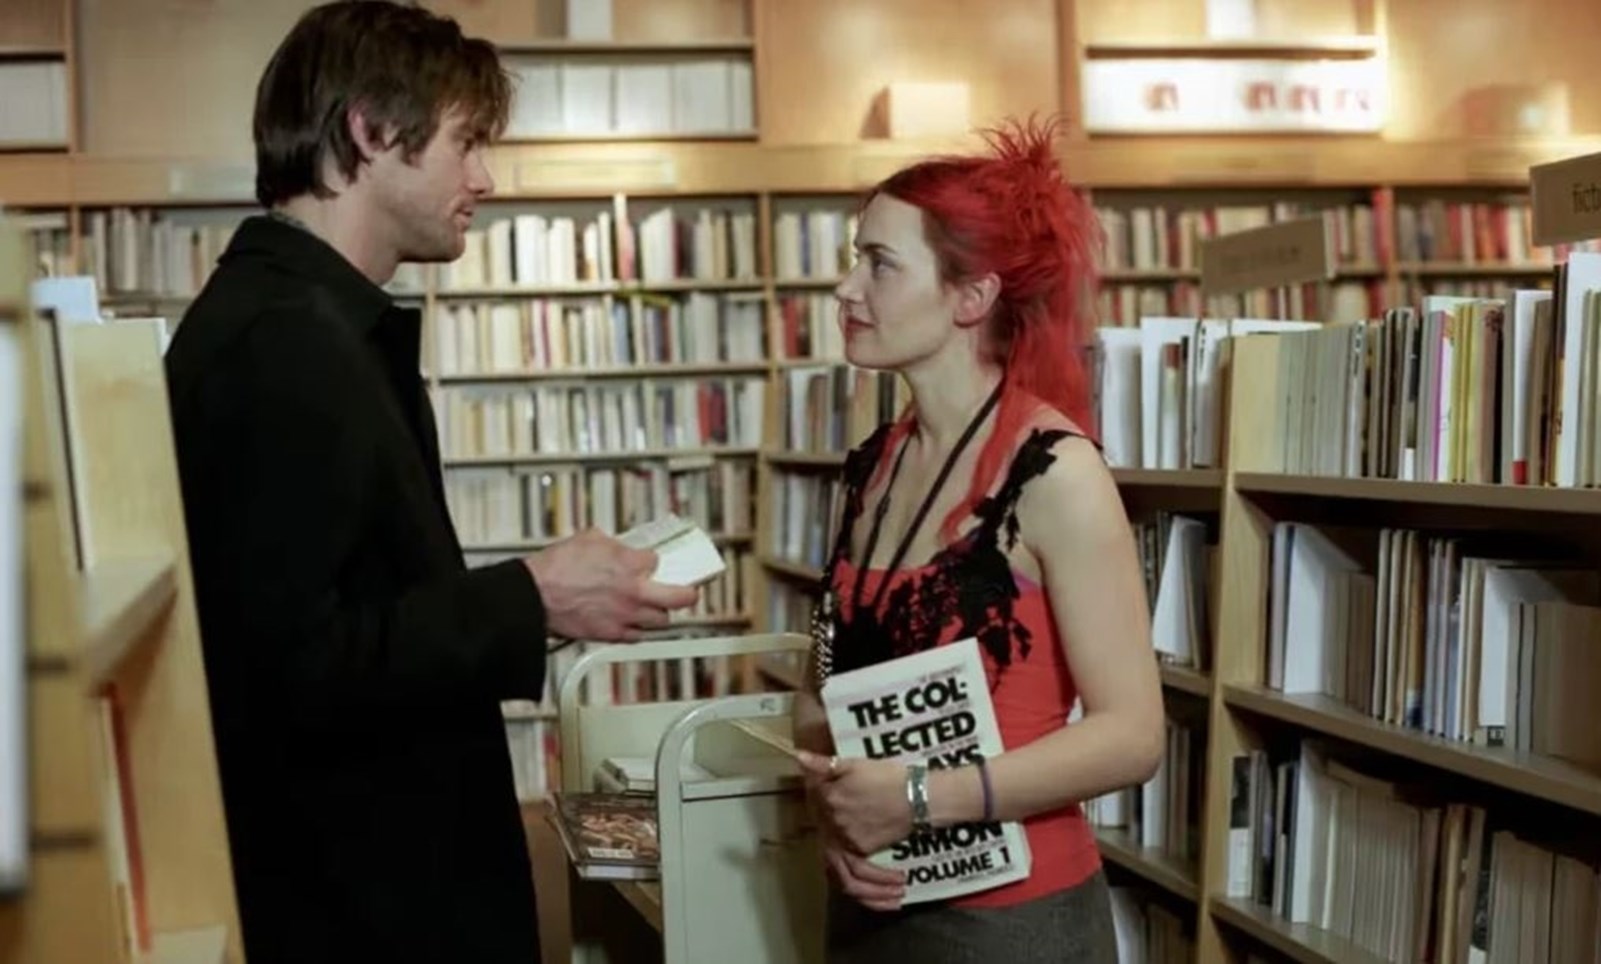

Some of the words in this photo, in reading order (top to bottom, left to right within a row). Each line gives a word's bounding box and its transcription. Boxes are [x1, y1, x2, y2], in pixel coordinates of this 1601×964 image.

[849, 694, 902, 728] THE
[864, 712, 976, 759] LECTED
[927, 745, 982, 771] AYS
[892, 822, 1002, 861] SIMON
[1000, 846, 1011, 865] 1
